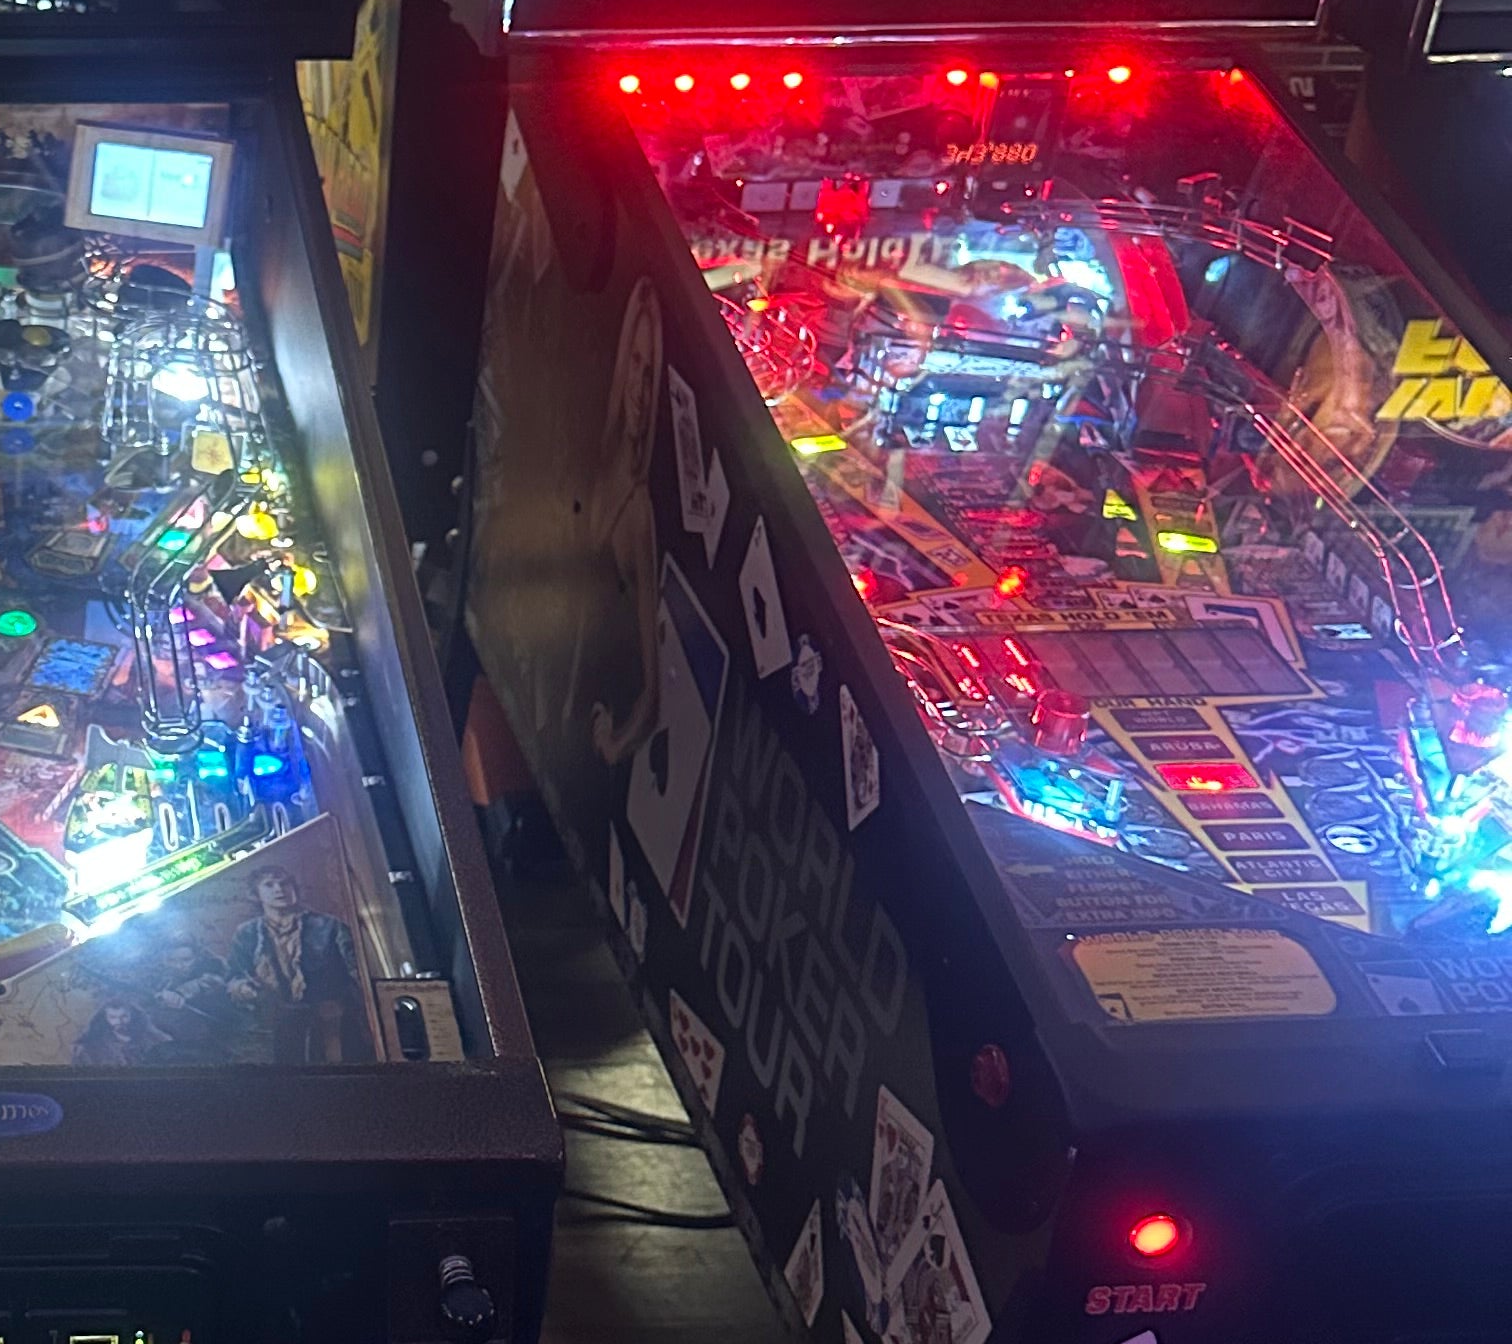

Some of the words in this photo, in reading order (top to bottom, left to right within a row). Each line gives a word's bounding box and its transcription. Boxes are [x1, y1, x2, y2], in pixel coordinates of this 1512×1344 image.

[984, 613, 1056, 625] TEXAS
[1059, 611, 1118, 623] HOLD
[1222, 830, 1288, 843] PARIS
[1234, 859, 1322, 872] ATLANTIC
[1264, 868, 1305, 878] CITY
[1282, 890, 1326, 902] LAS
[1084, 1282, 1207, 1315] START
